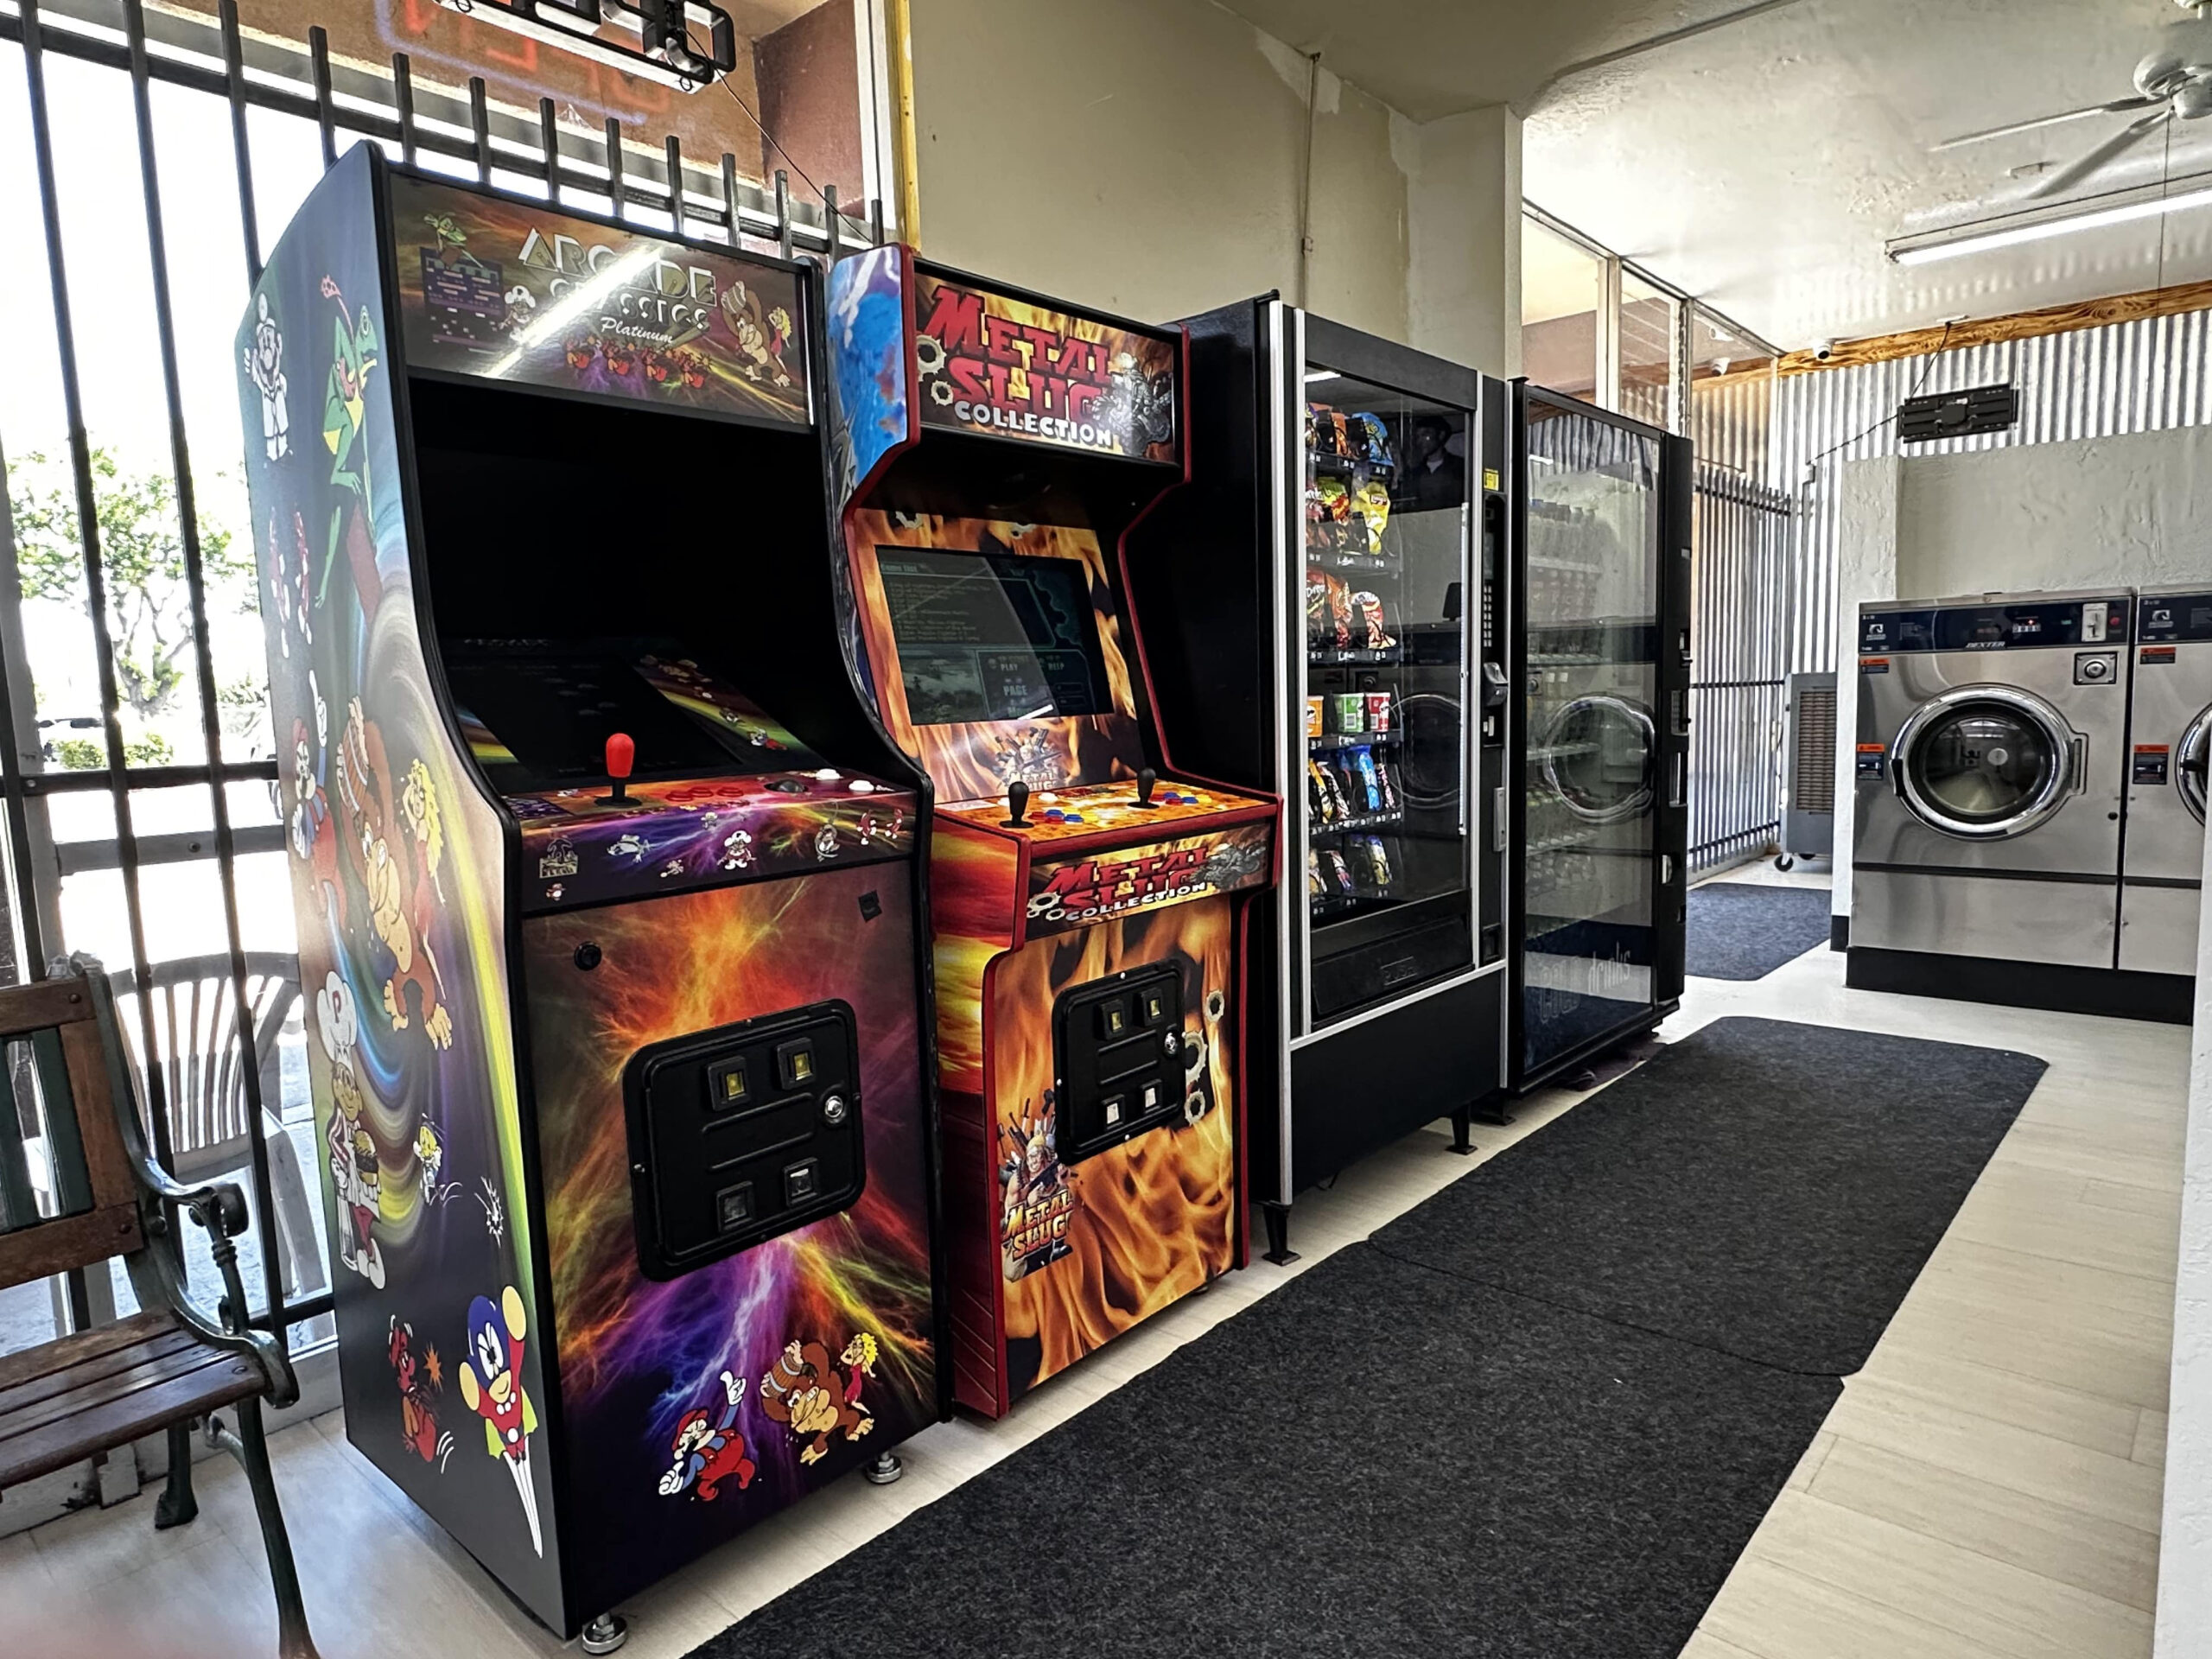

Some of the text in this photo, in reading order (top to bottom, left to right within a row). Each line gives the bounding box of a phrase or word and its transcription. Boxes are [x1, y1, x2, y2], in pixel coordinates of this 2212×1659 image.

[600, 316, 674, 345] Platinum
[922, 285, 1113, 385] METAL
[948, 355, 1105, 426] SLUG
[953, 400, 1113, 449] COLLECTION
[1965, 640, 2006, 649] DEXTER
[1002, 684, 1028, 696] PAGE
[1042, 846, 1210, 893] METAL
[1062, 868, 1200, 912] SLUG
[1065, 882, 1208, 922] COLLECTION
[1587, 940, 1631, 996] drinks
[1002, 1190, 1074, 1238] METAL
[1012, 1214, 1067, 1259] SLUG
